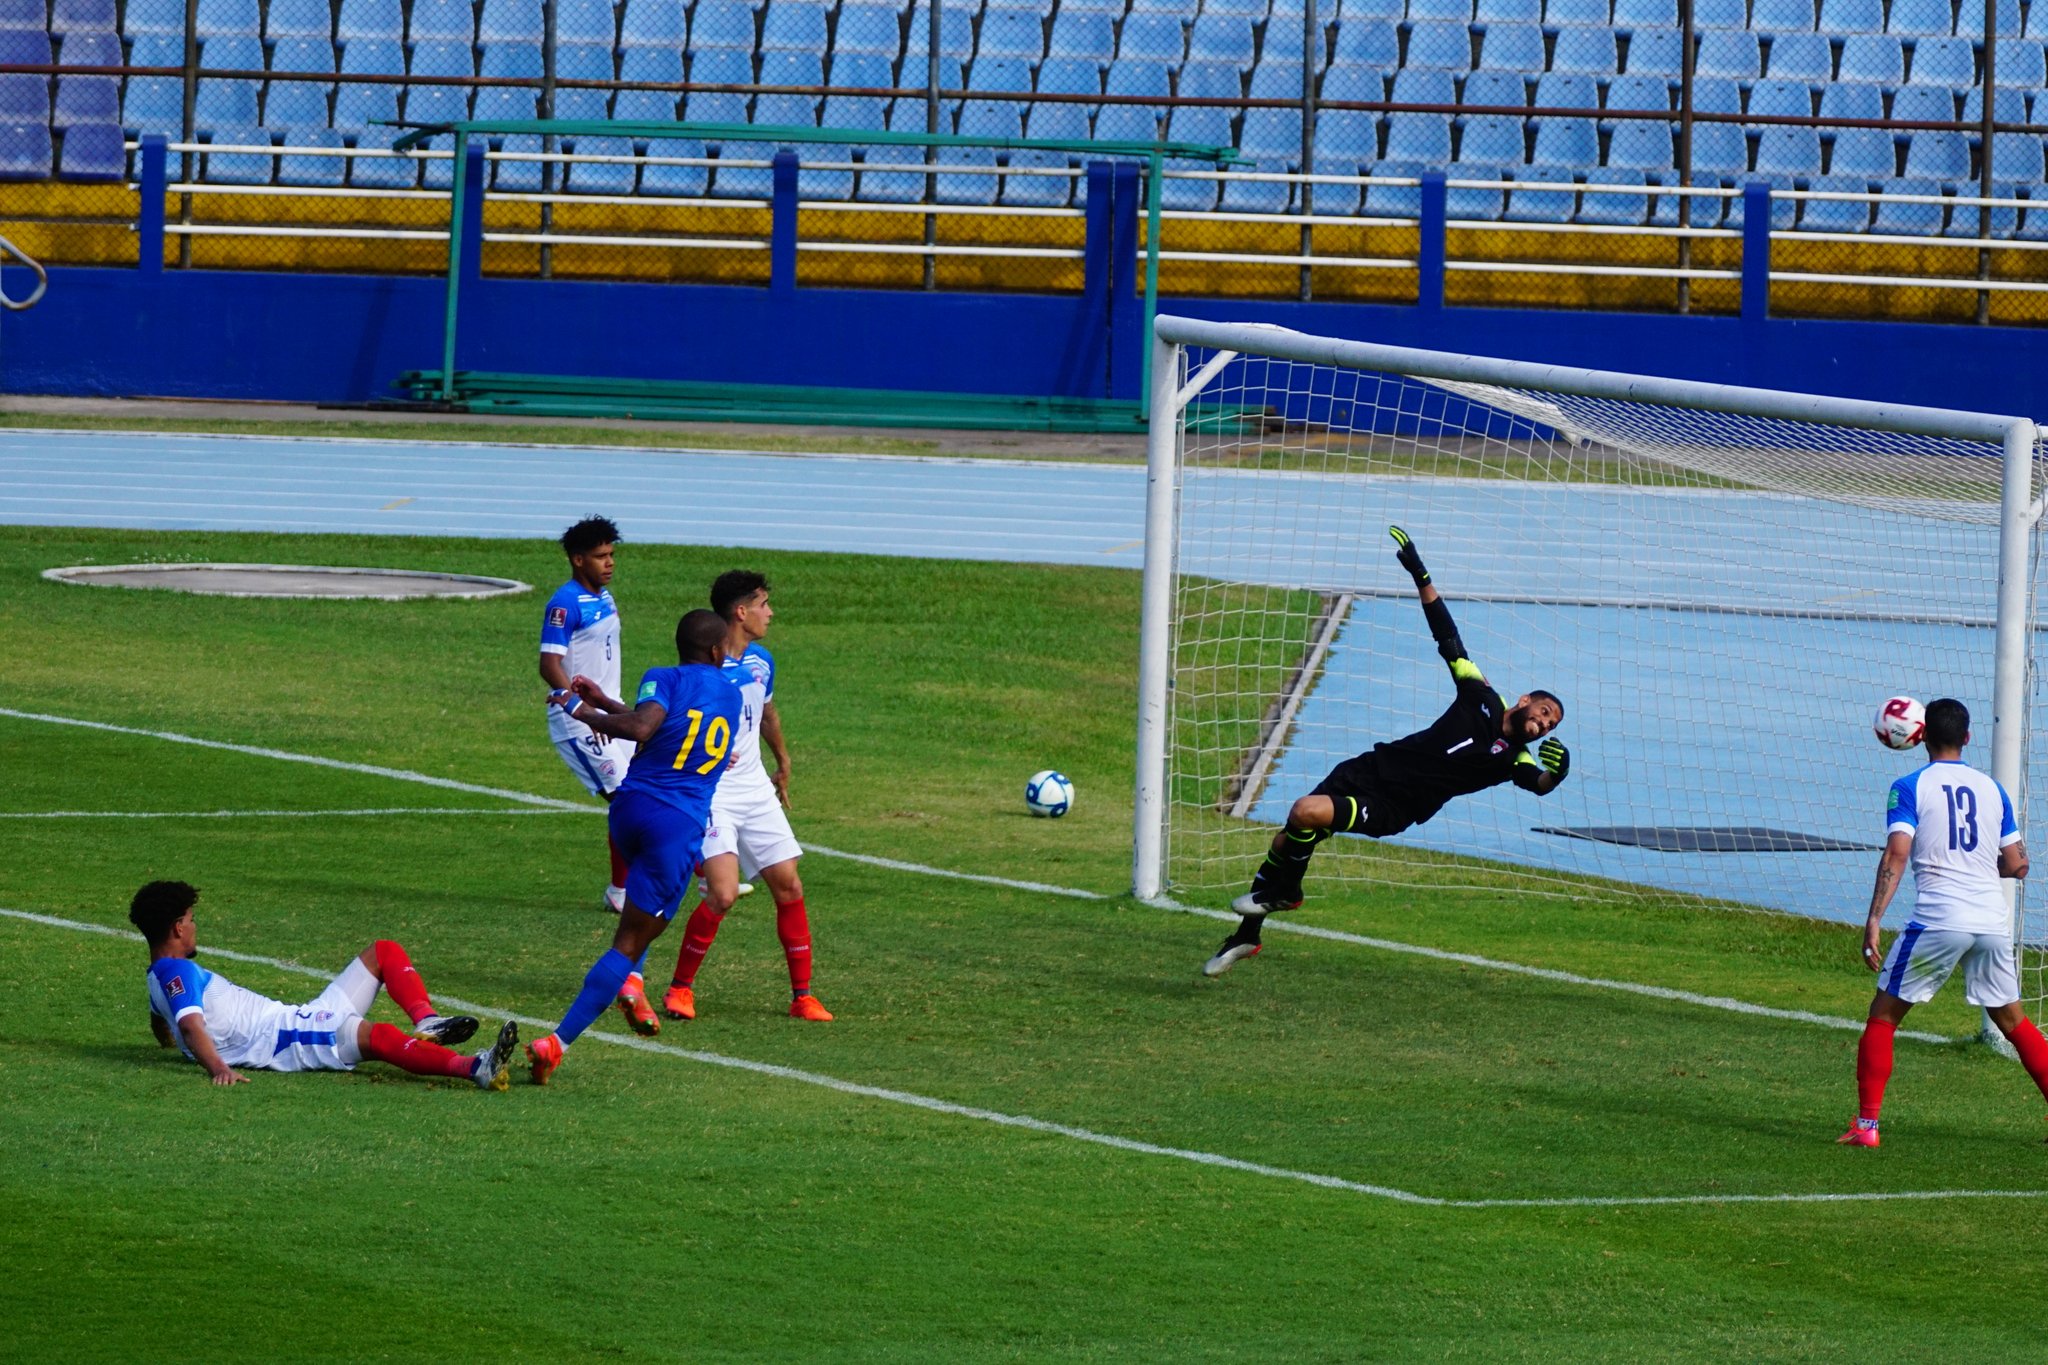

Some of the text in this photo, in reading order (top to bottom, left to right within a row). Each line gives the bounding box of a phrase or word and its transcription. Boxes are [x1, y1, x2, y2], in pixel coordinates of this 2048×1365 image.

[745, 704, 752, 732] 4
[672, 709, 731, 775] 19
[1447, 738, 1473, 754] 1
[1941, 784, 1979, 852] 13
